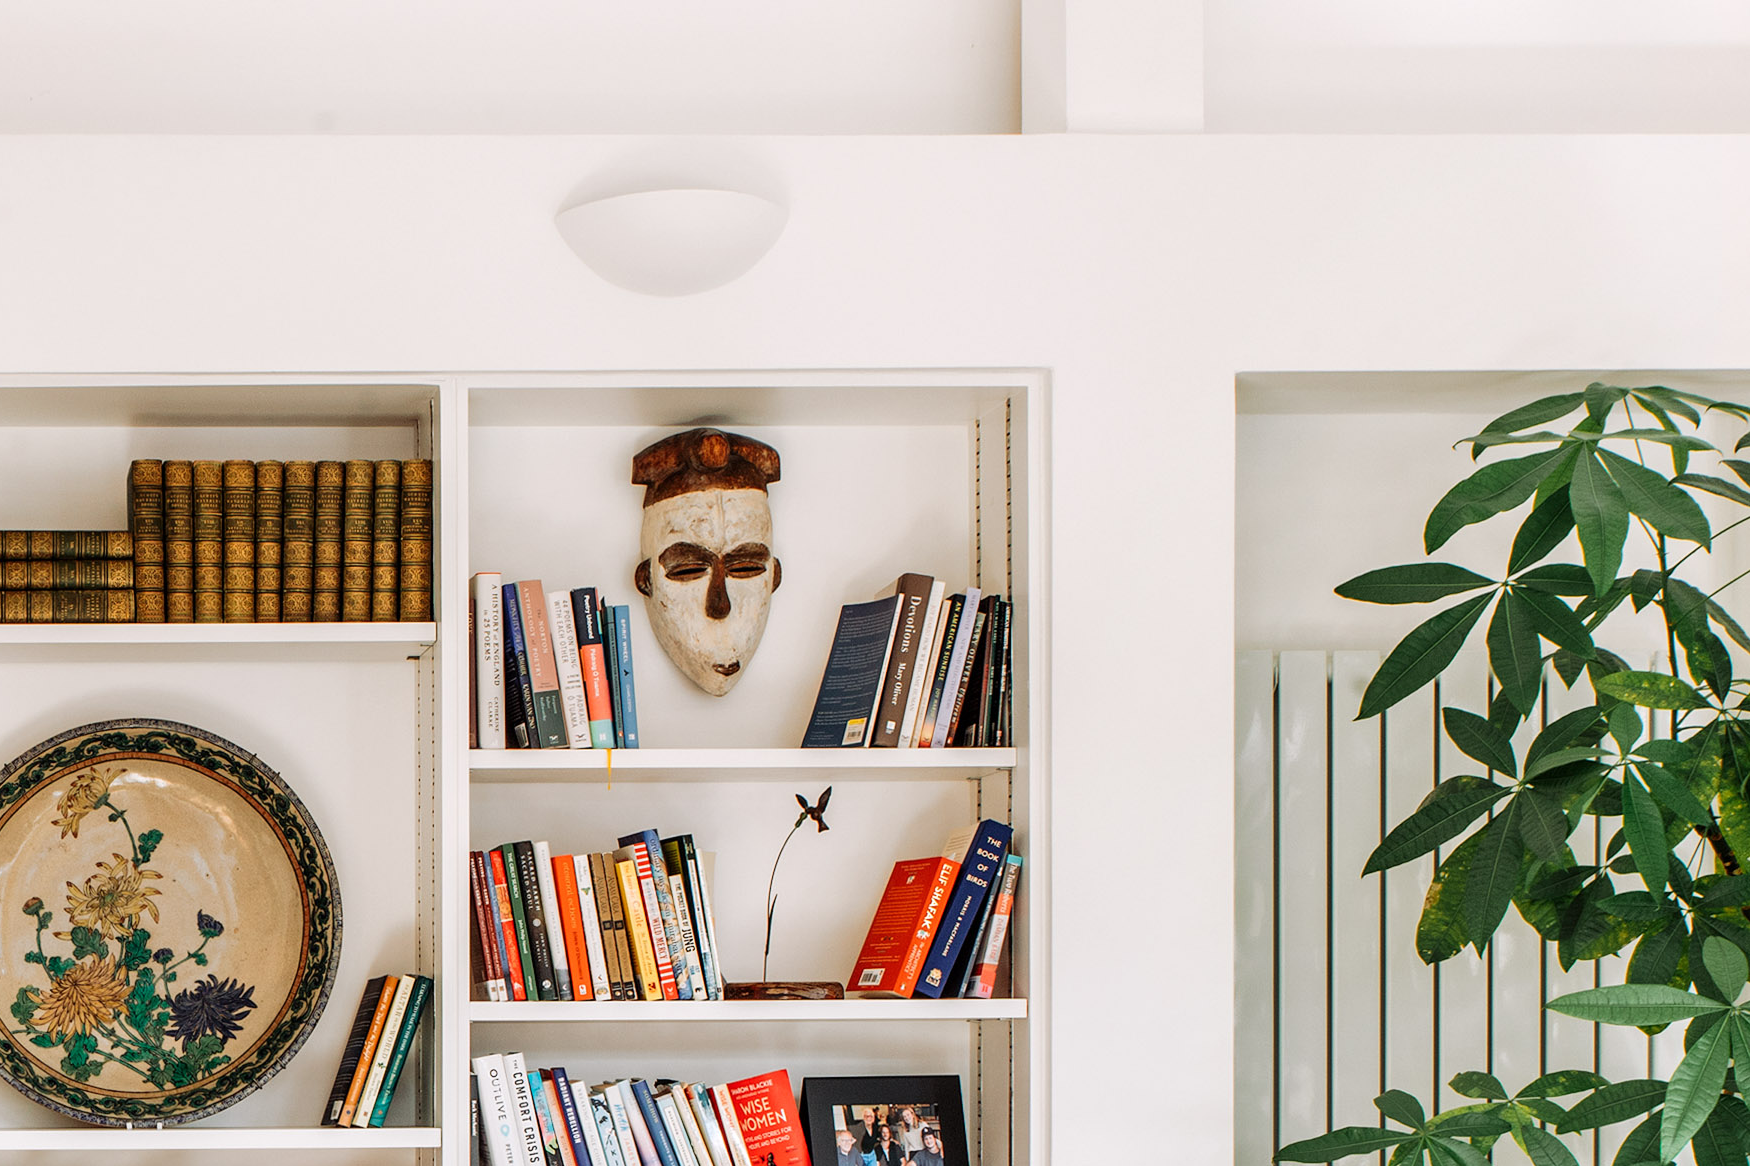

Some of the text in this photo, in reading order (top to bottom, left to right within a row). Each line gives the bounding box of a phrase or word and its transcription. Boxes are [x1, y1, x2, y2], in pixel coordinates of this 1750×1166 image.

[484, 619, 490, 628] 25
[538, 620, 548, 654] NORTON
[891, 595, 921, 706] Devotions Mary Oliver
[937, 601, 961, 682] AN AMERICAN SUNRISE
[961, 620, 982, 683] MARY OLIVER
[977, 848, 998, 862] BOOK
[987, 837, 1001, 848] THE
[521, 855, 529, 886] SACRED
[528, 851, 541, 911] SACRED EARTH
[966, 874, 987, 887] BIRDS
[977, 864, 988, 872] OF
[920, 863, 952, 929] ELIF SHAFAK
[998, 862, 1018, 914] The Two Roberts
[652, 917, 669, 960] WILD MERCY
[681, 928, 695, 953] JUNG
[490, 1068, 507, 1121] OUTLIVE
[514, 1072, 531, 1122] COMFORT
[740, 1098, 771, 1113] WISE
[741, 1109, 787, 1131] WOMEN
